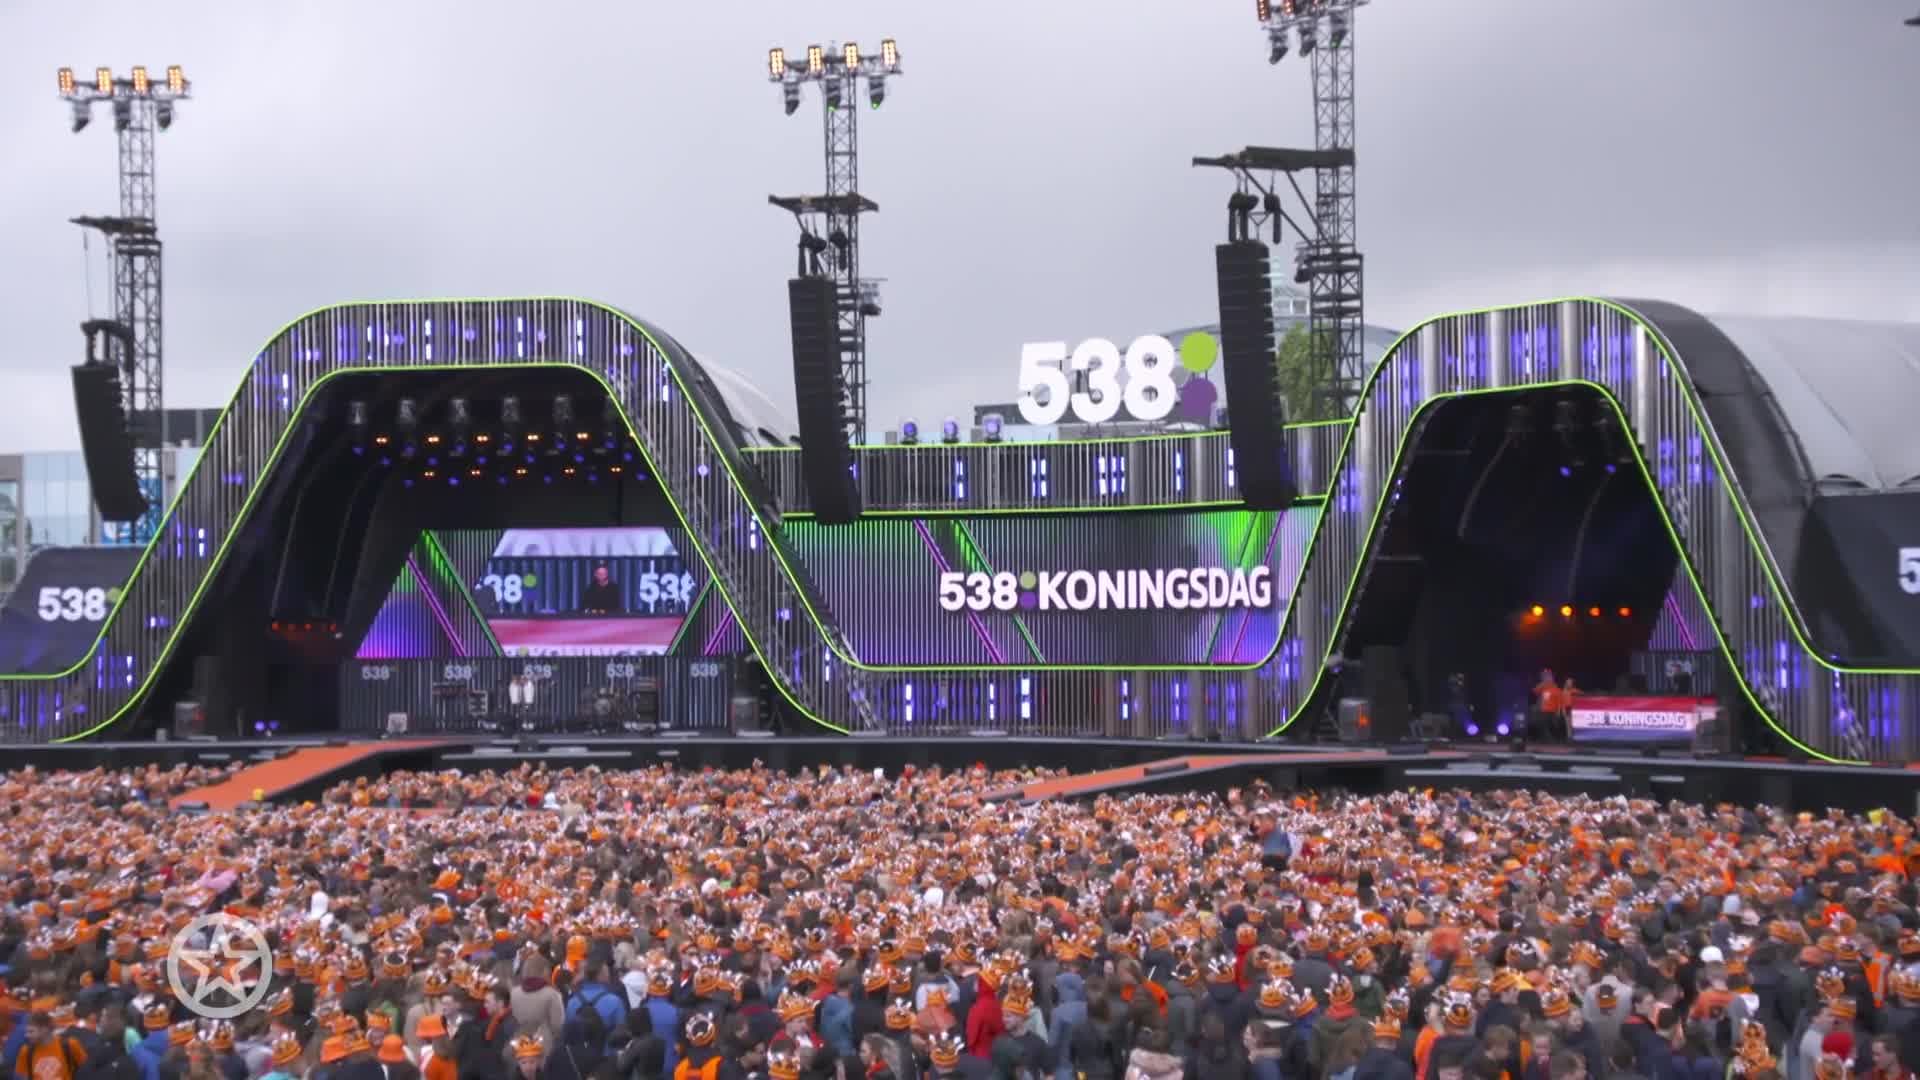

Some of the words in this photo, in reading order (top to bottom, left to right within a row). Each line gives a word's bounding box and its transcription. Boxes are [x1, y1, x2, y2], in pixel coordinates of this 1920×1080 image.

[1017, 334, 1176, 425] 538
[939, 571, 1018, 611] 538
[1038, 566, 1271, 610] KONINGSDAG
[38, 586, 106, 622] 538
[362, 666, 391, 681] 538
[444, 665, 473, 680] 538
[690, 663, 719, 678] 538
